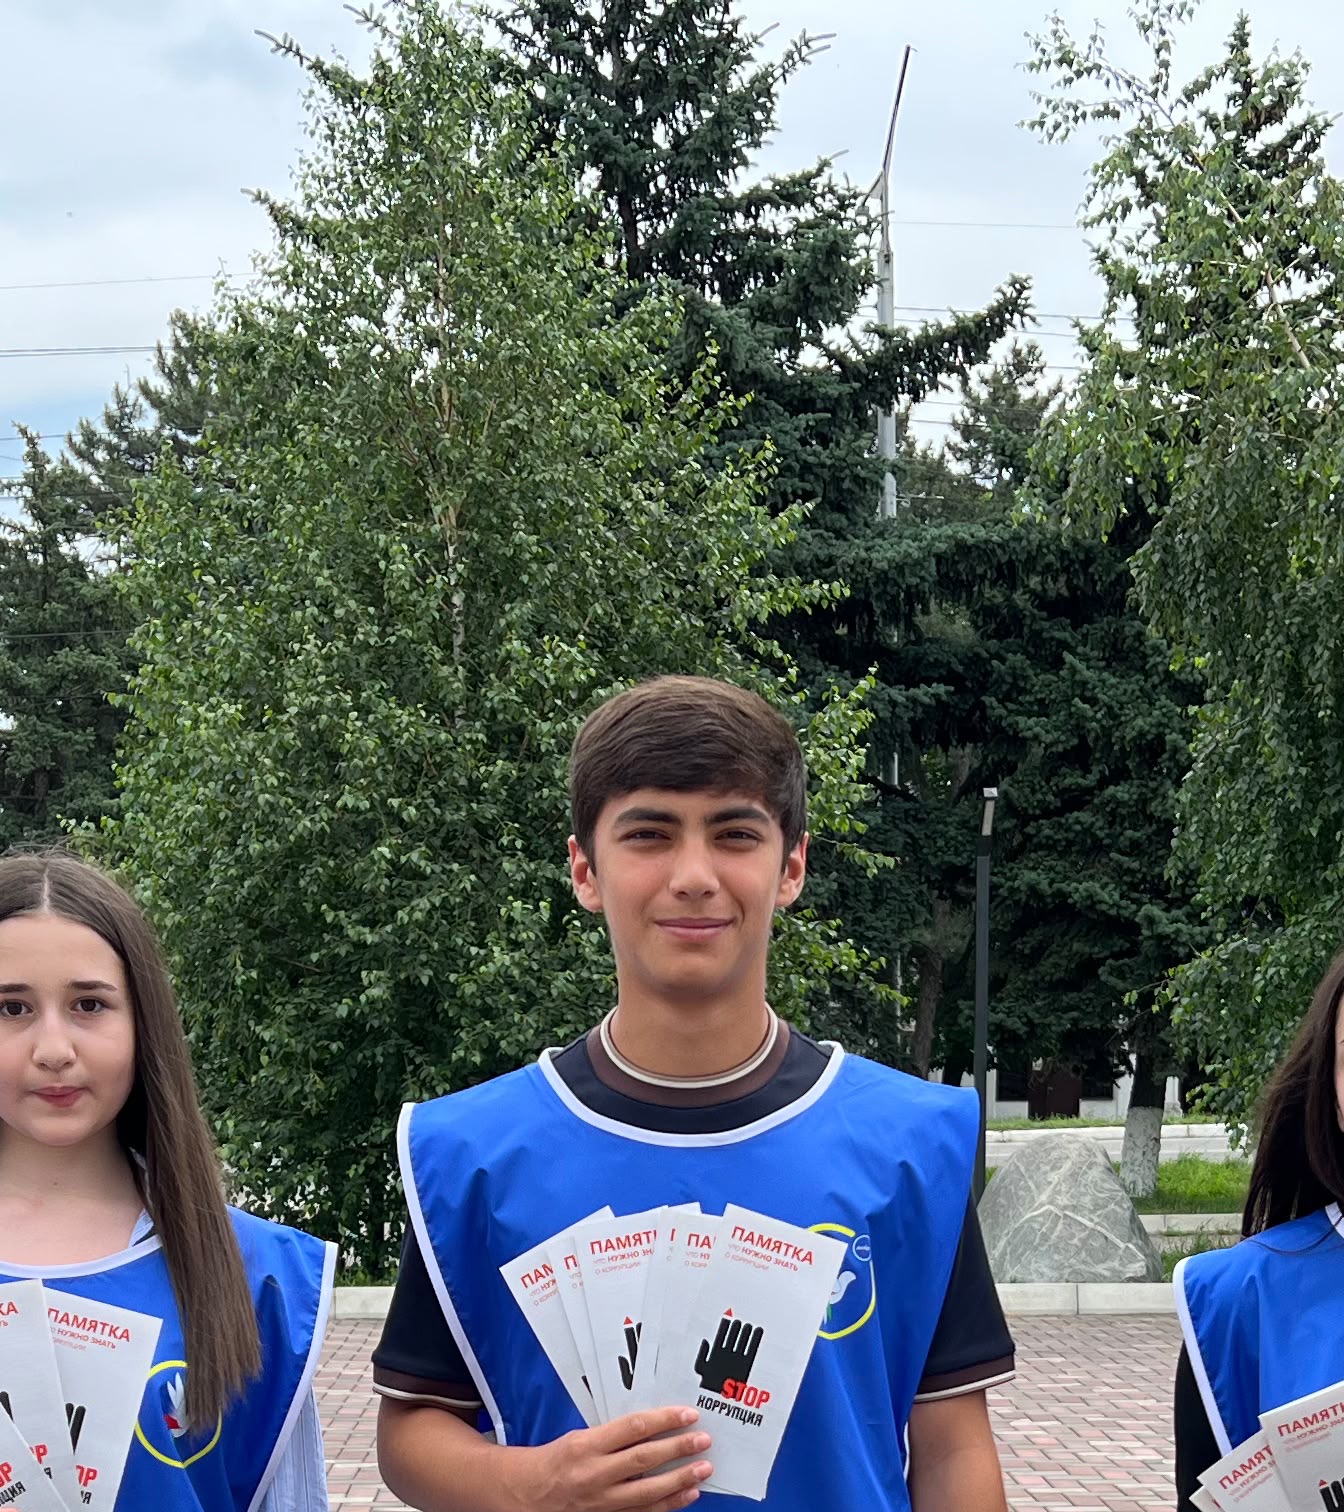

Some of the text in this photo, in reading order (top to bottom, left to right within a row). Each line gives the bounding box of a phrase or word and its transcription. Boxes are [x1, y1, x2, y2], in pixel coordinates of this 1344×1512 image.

[590, 1230, 656, 1255] ПАМЯТ
[608, 1250, 639, 1262] НУЖНО
[731, 1226, 813, 1265] ПАМЯТКА
[741, 1247, 772, 1262] НУЖНО
[773, 1258, 798, 1271] ЗНАТЬ
[48, 1307, 130, 1342] ПАМЯТКА
[721, 1378, 770, 1409] STOP
[696, 1395, 763, 1427] КОРРУПЦИЯ
[1219, 1445, 1272, 1489] ПАМЯТ
